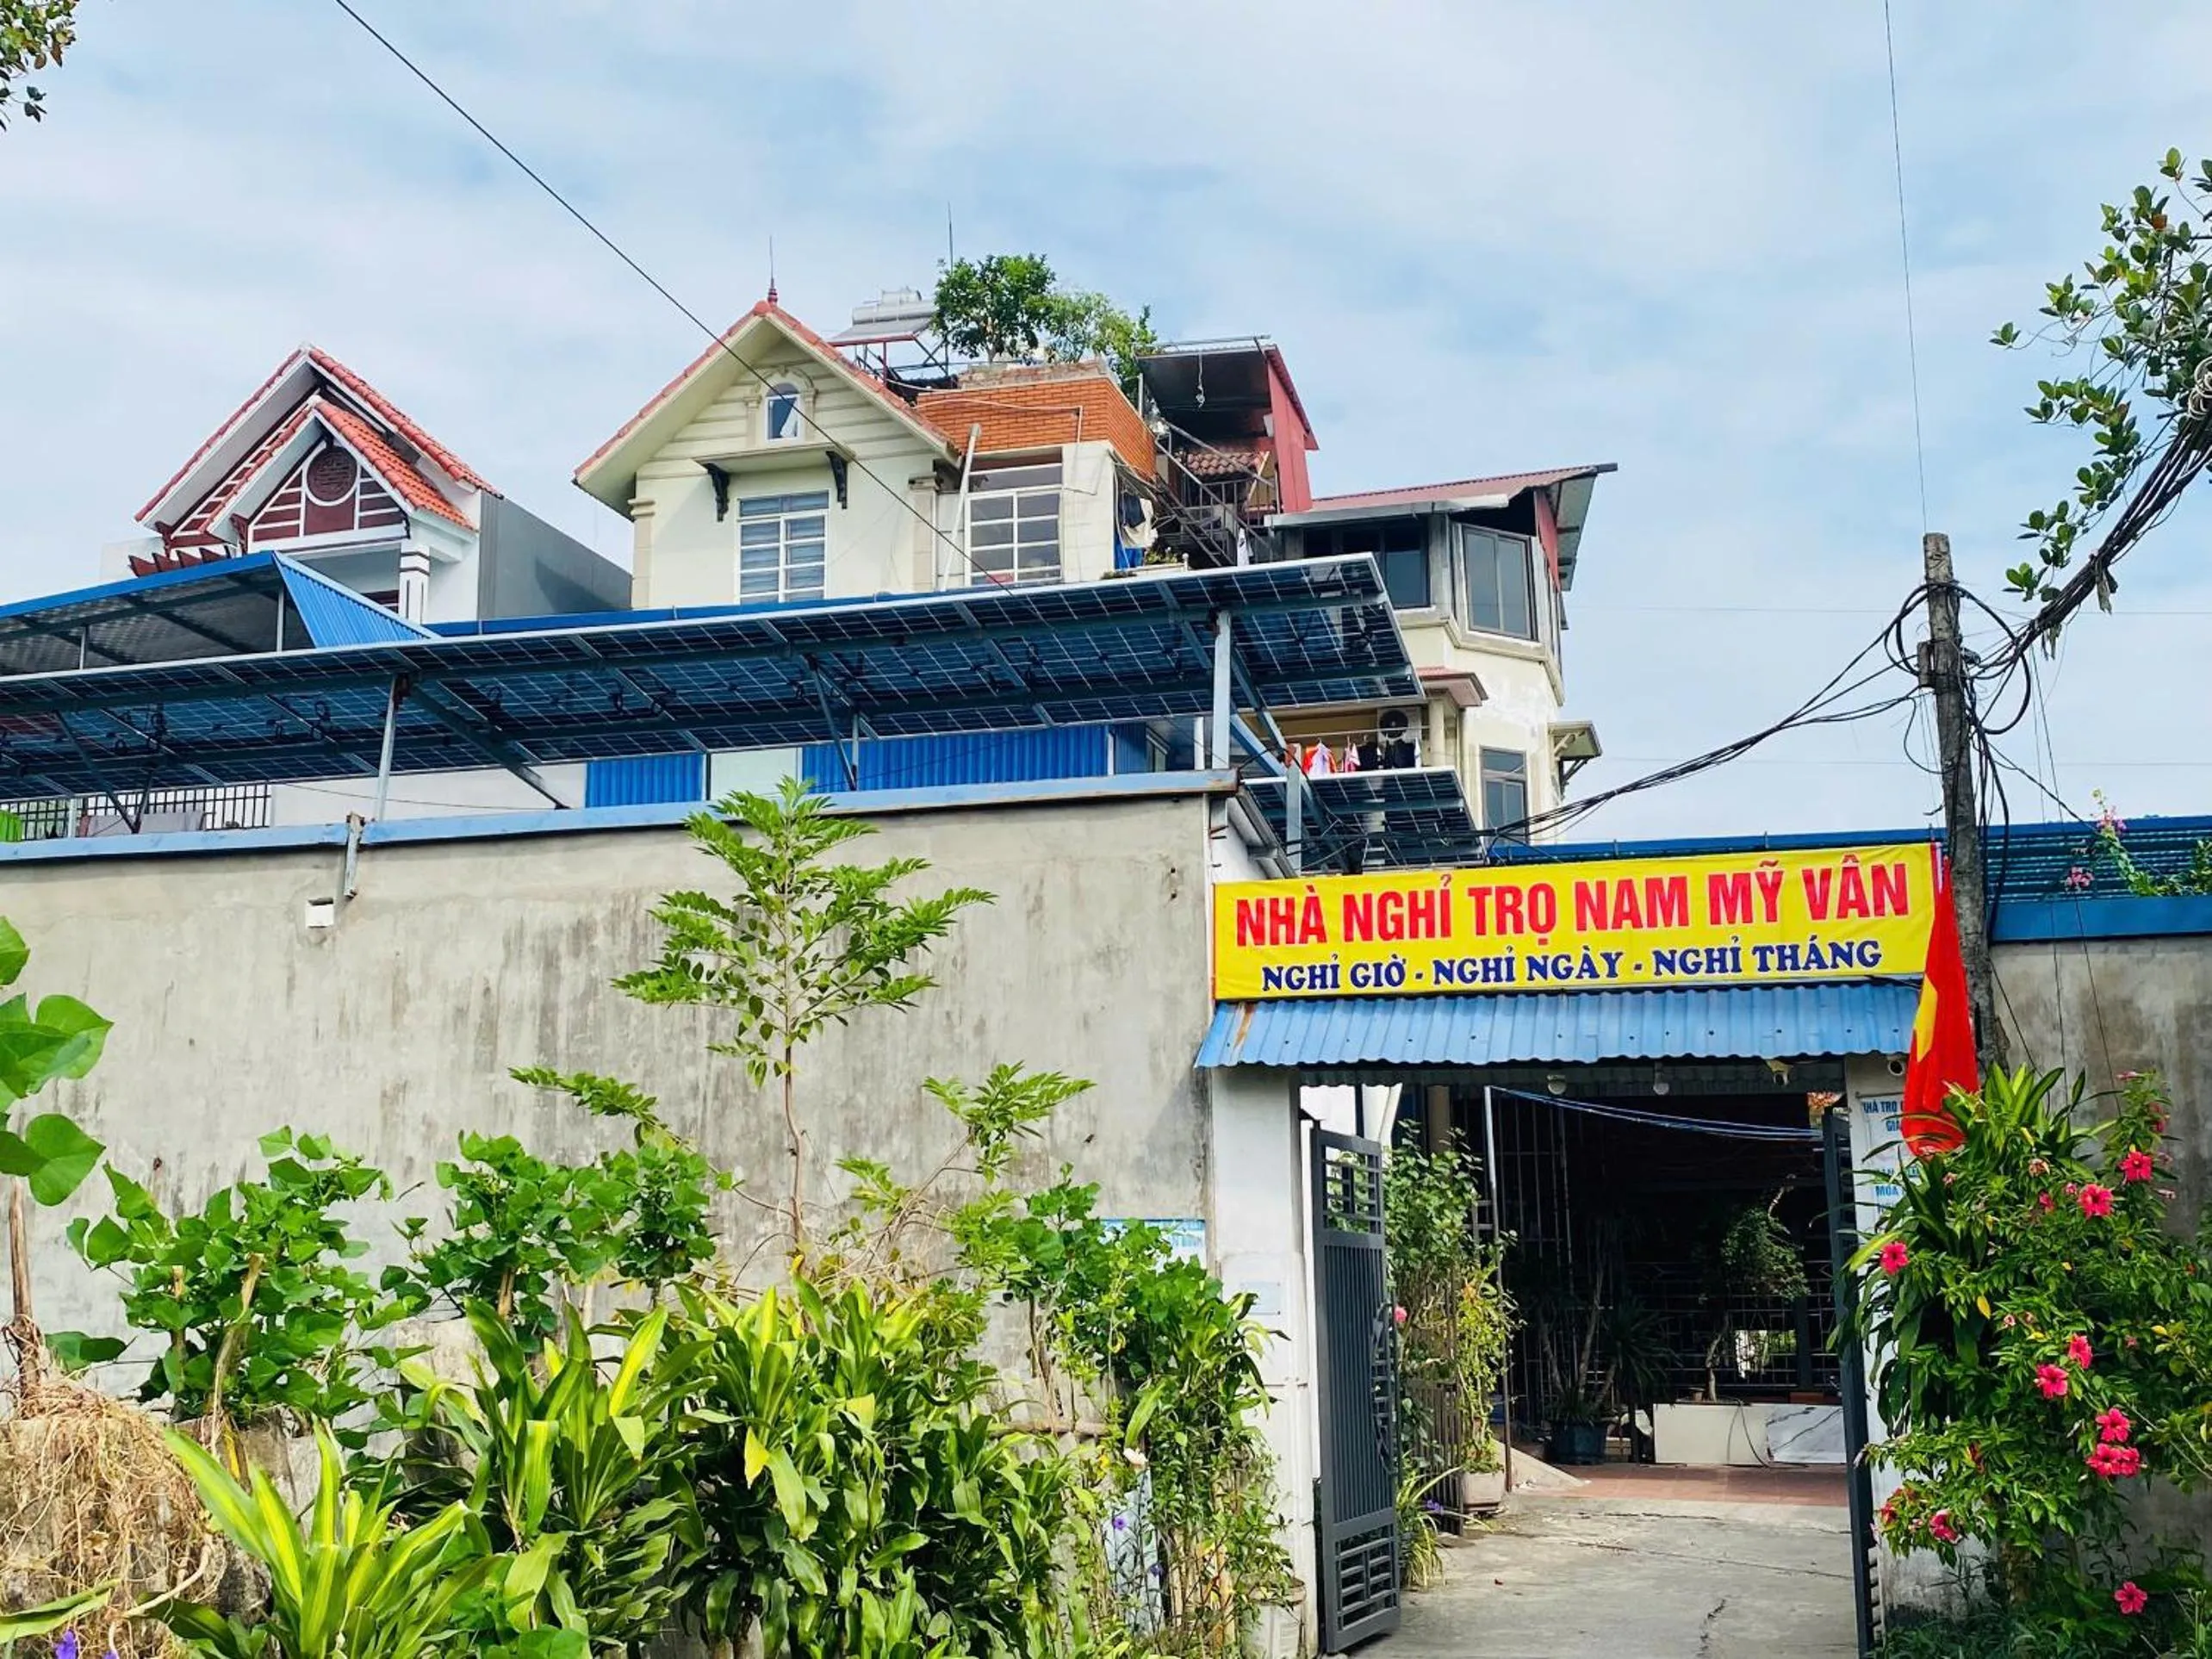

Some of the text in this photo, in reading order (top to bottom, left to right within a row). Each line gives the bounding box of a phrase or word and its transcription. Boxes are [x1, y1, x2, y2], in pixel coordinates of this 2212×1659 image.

[1236, 854, 1910, 947] NHÀ NGHỈ TRỌ NAM MỸ VÂN
[1261, 953, 1340, 991] NGHỈ
[1349, 954, 1407, 988] GIỜ
[1432, 945, 1515, 985] NGHỈ
[1526, 945, 1624, 982] NGÀY
[1652, 935, 1743, 976] NGHỈ
[1752, 935, 1883, 972] THÁNG
